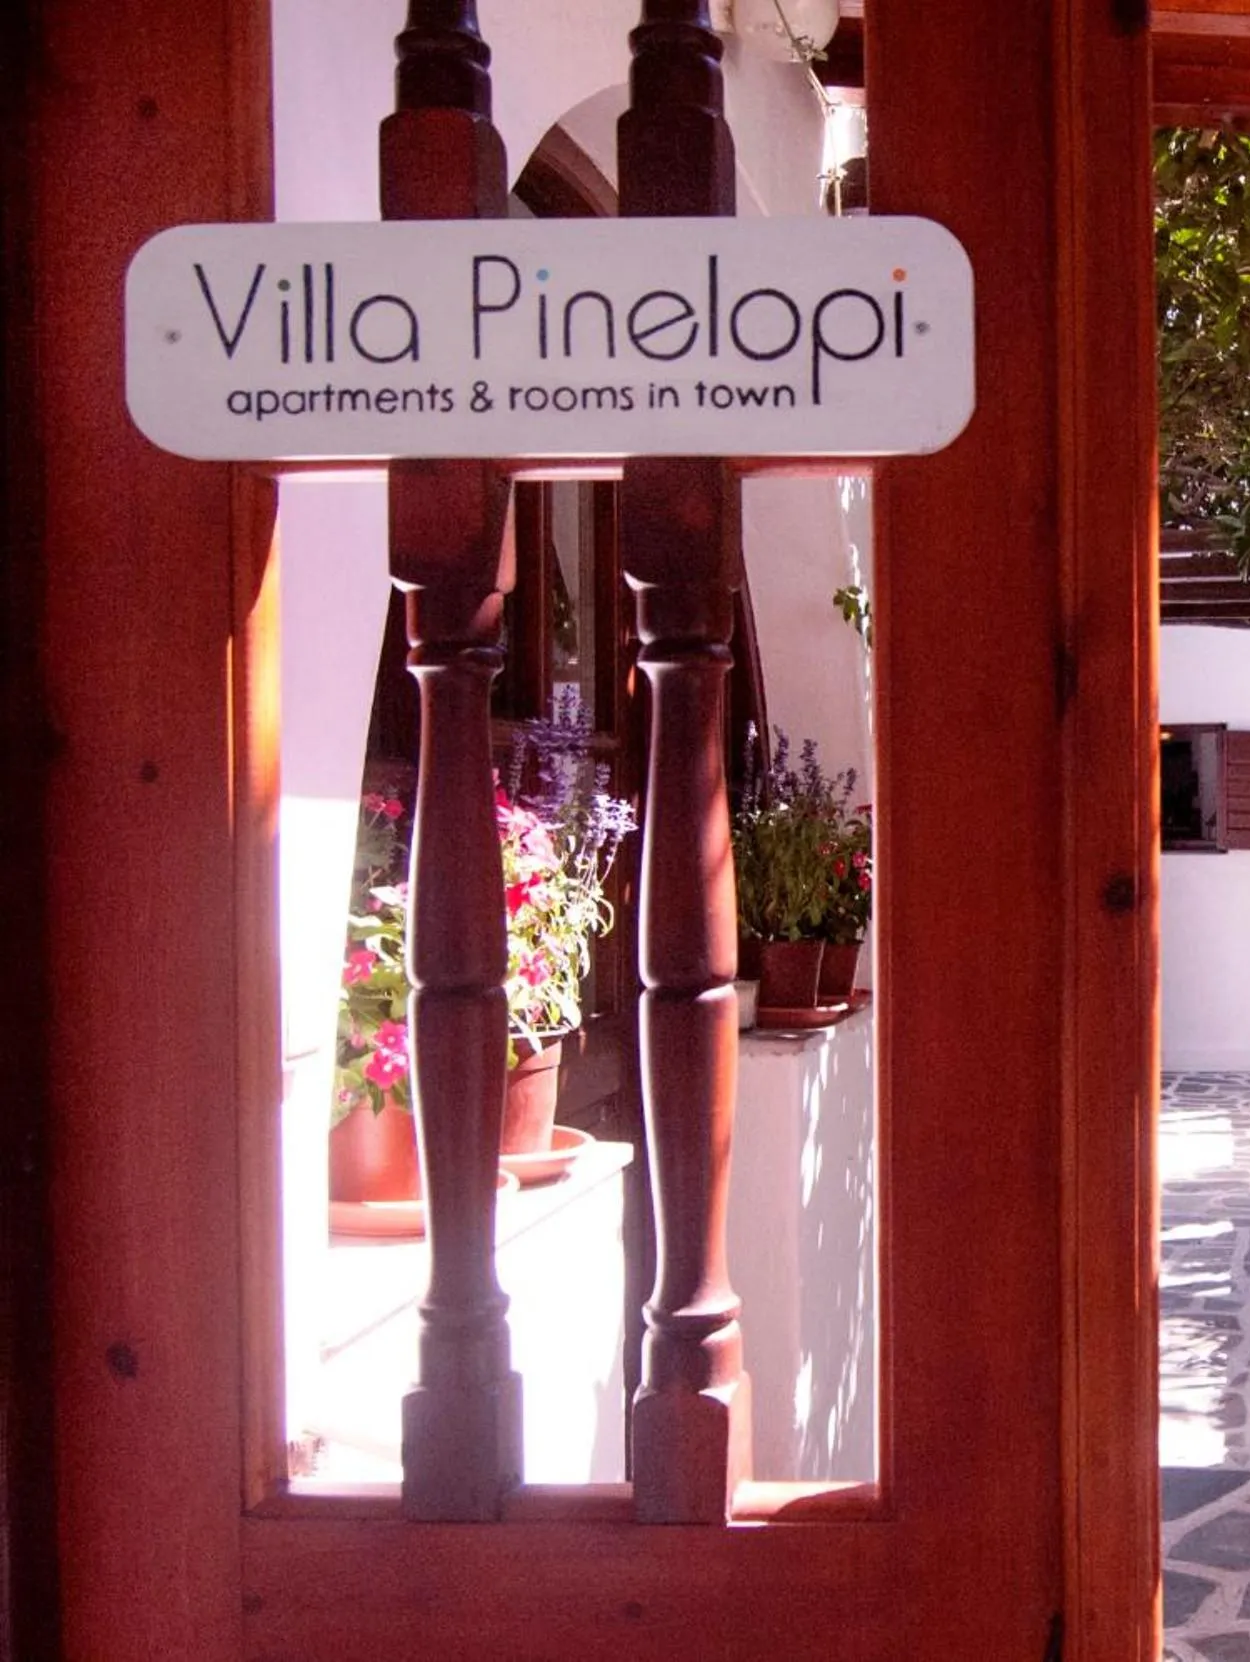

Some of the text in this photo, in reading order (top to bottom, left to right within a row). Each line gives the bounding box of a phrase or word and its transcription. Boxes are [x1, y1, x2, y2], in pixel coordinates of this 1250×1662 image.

[192, 253, 905, 406] Villa Pinelopi
[226, 380, 796, 422] apartments & rooms in town
